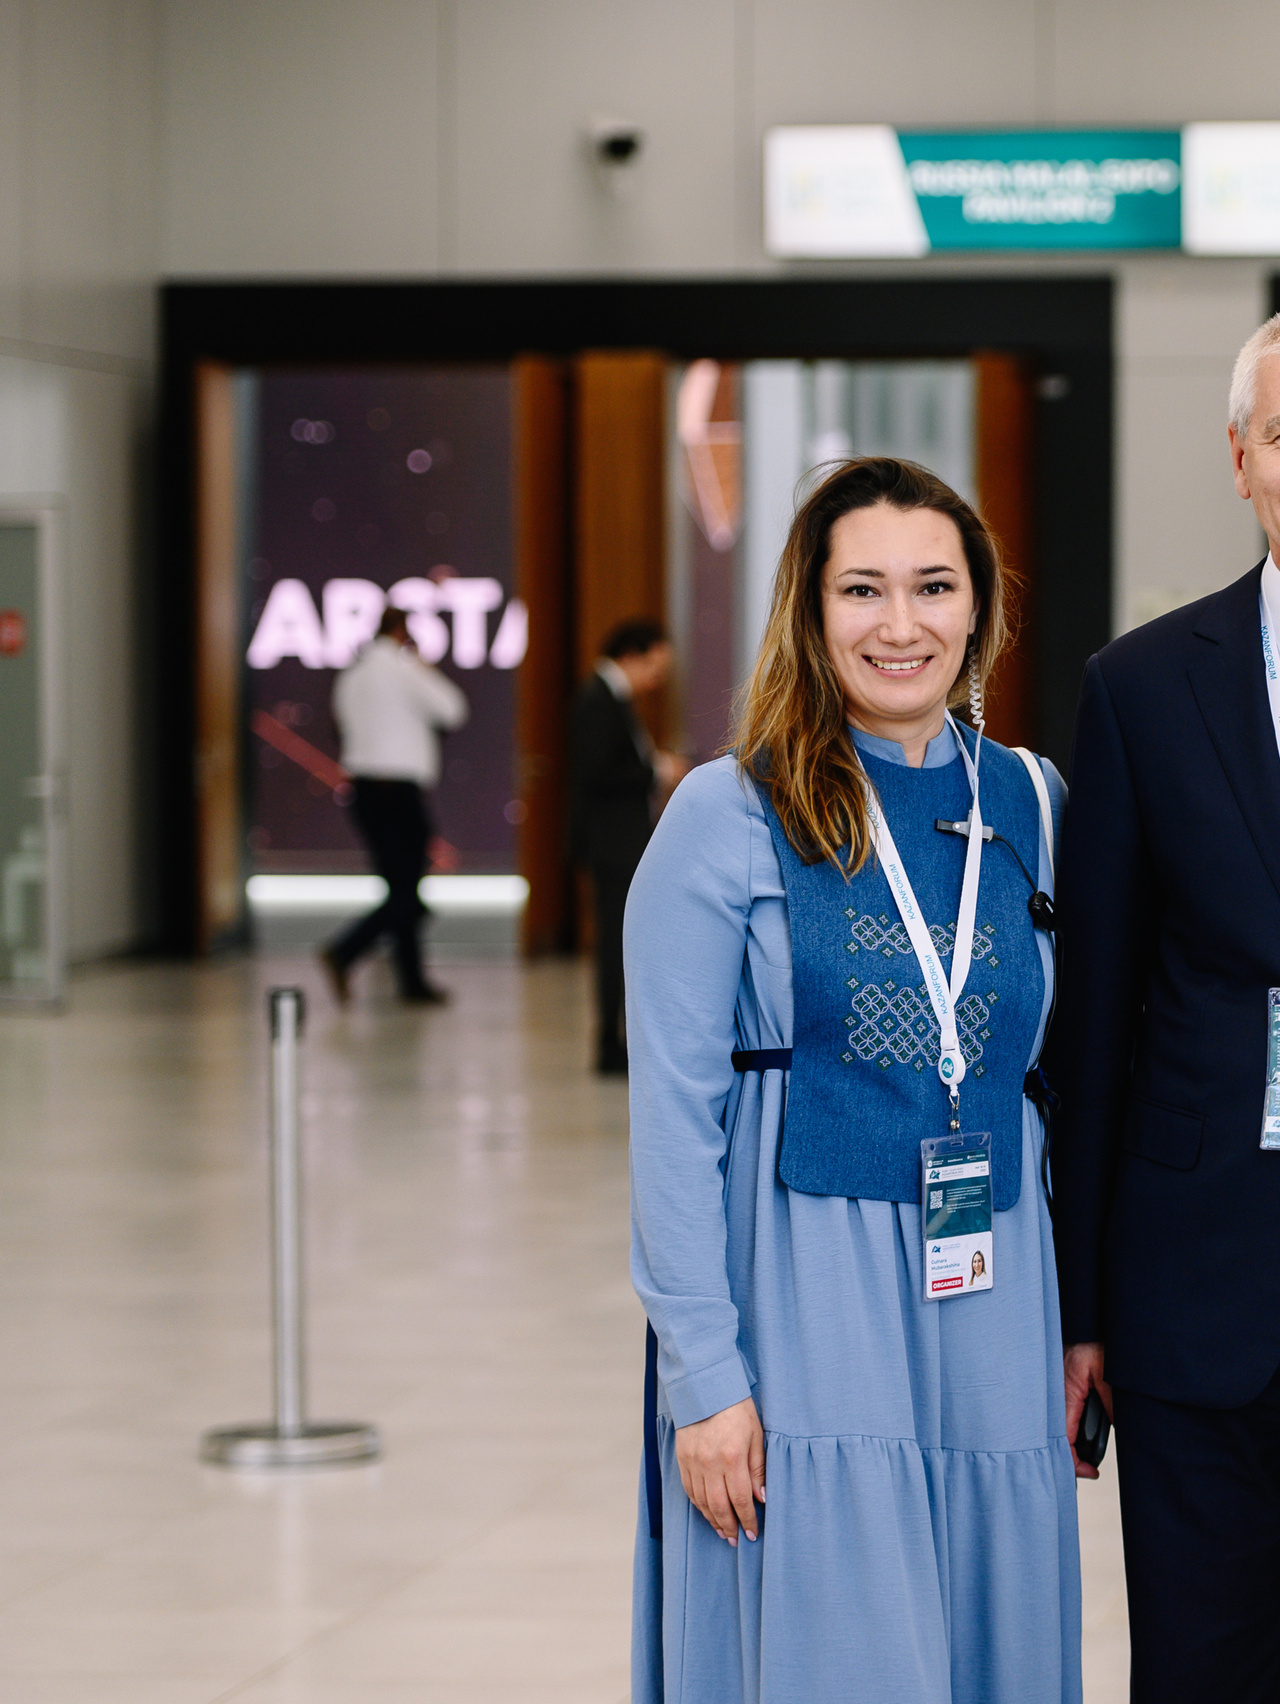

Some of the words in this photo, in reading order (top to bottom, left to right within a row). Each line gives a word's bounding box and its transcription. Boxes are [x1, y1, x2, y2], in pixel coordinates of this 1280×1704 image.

[1261, 625, 1278, 680] KAZANFORUM
[889, 863, 916, 920] KAZANFORUM
[924, 954, 948, 1015] KAZANFORUM
[933, 1279, 962, 1289] ORGANIZER
